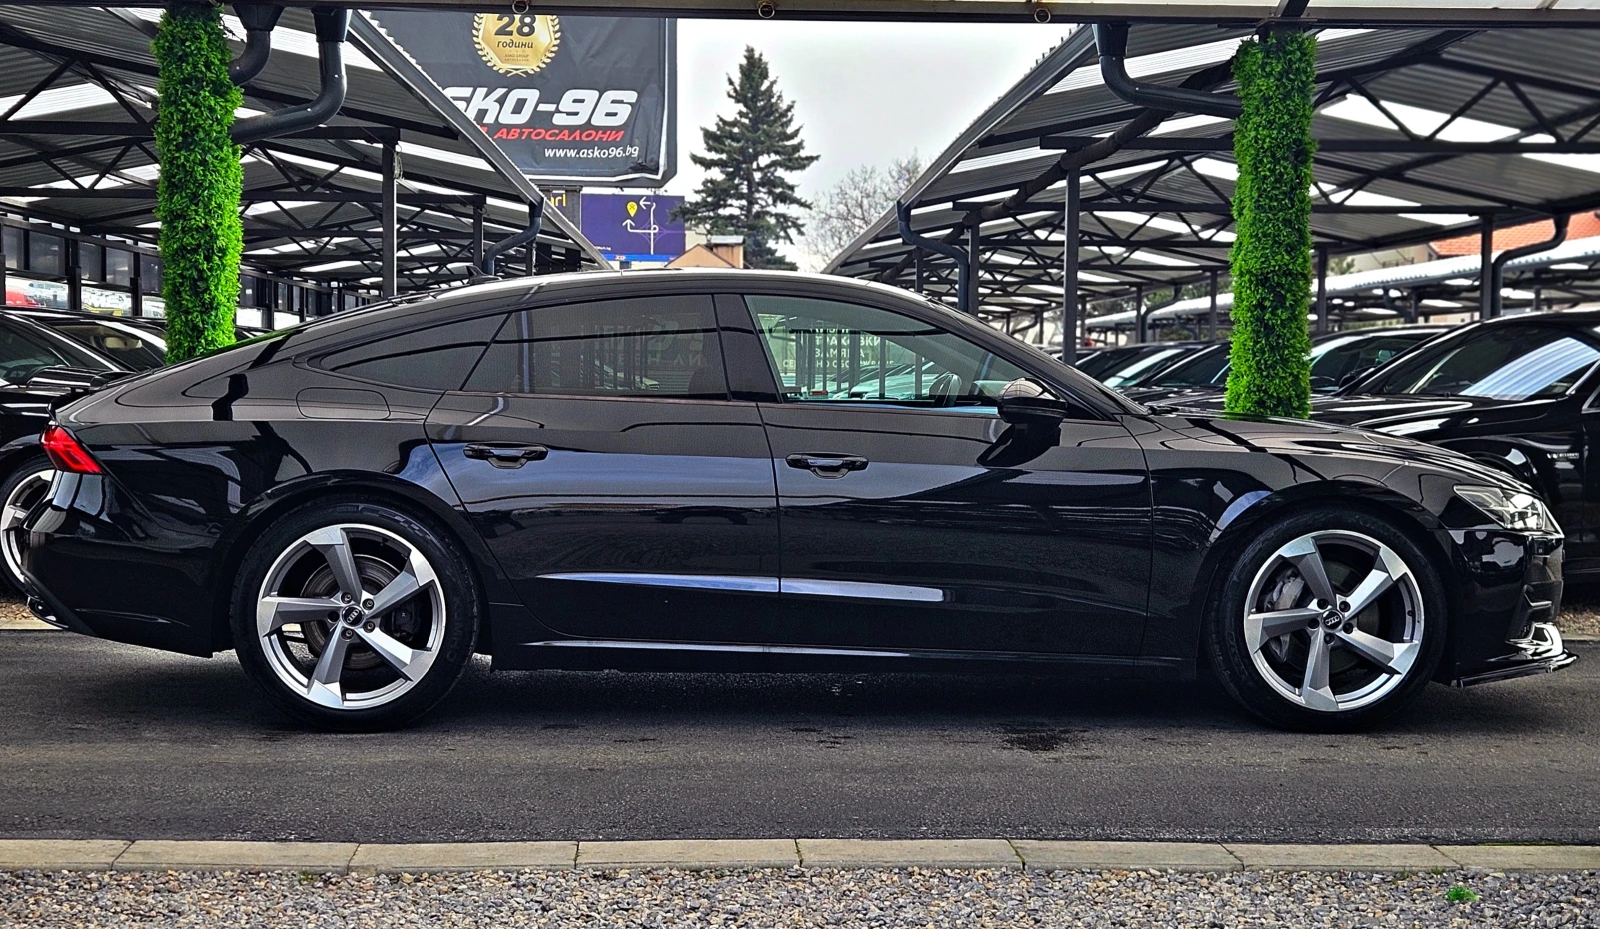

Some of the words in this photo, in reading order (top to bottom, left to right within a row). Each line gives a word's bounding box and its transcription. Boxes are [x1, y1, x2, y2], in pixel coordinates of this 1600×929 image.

[494, 14, 536, 37] 28
[497, 39, 534, 49] години
[494, 127, 625, 142] АВТОСАЛОНИ
[544, 144, 639, 159] www.asko96.bg
